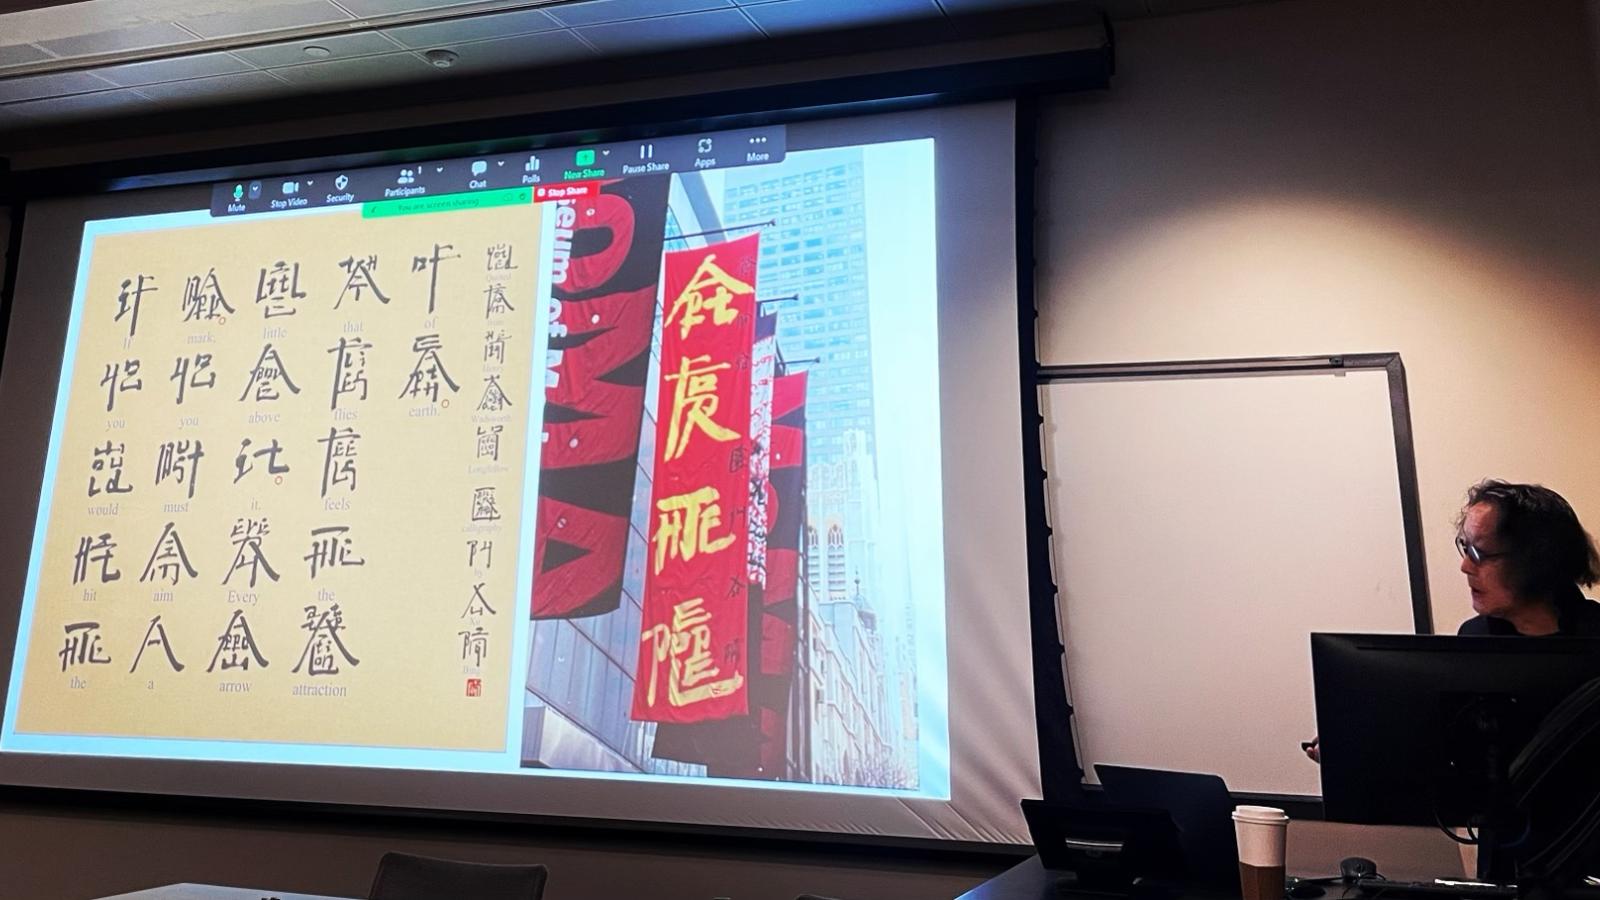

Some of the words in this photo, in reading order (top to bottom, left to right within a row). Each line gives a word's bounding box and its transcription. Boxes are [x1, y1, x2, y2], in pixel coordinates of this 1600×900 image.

[694, 157, 716, 168] Apps
[747, 152, 769, 162] More
[564, 170, 583, 180] New
[583, 168, 605, 179] Share
[622, 163, 646, 174] Pause
[646, 161, 670, 173] Share
[469, 179, 487, 189] Chat
[522, 174, 540, 184] Polls
[326, 192, 354, 204] Security
[385, 185, 426, 198] Participants
[547, 188, 565, 198] Stop
[565, 186, 588, 197] Share
[227, 204, 246, 213] Mute
[270, 199, 287, 209] Stop
[287, 197, 308, 208] Video
[343, 320, 364, 333] that
[424, 317, 438, 330] of
[187, 332, 217, 345] mark,
[262, 327, 288, 340] little
[333, 406, 358, 421] flies
[408, 405, 441, 418] earth.
[180, 415, 199, 428] you
[248, 412, 280, 425] above
[106, 418, 126, 433] you
[87, 503, 119, 516] would
[163, 502, 190, 513] must
[323, 498, 351, 511] feels
[83, 589, 98, 602] hit
[152, 590, 174, 602] aim
[227, 589, 259, 607] Every
[317, 589, 336, 601] the
[70, 677, 87, 690] the
[147, 680, 155, 690] a
[218, 680, 252, 693] arrow
[291, 683, 348, 698] attraction
